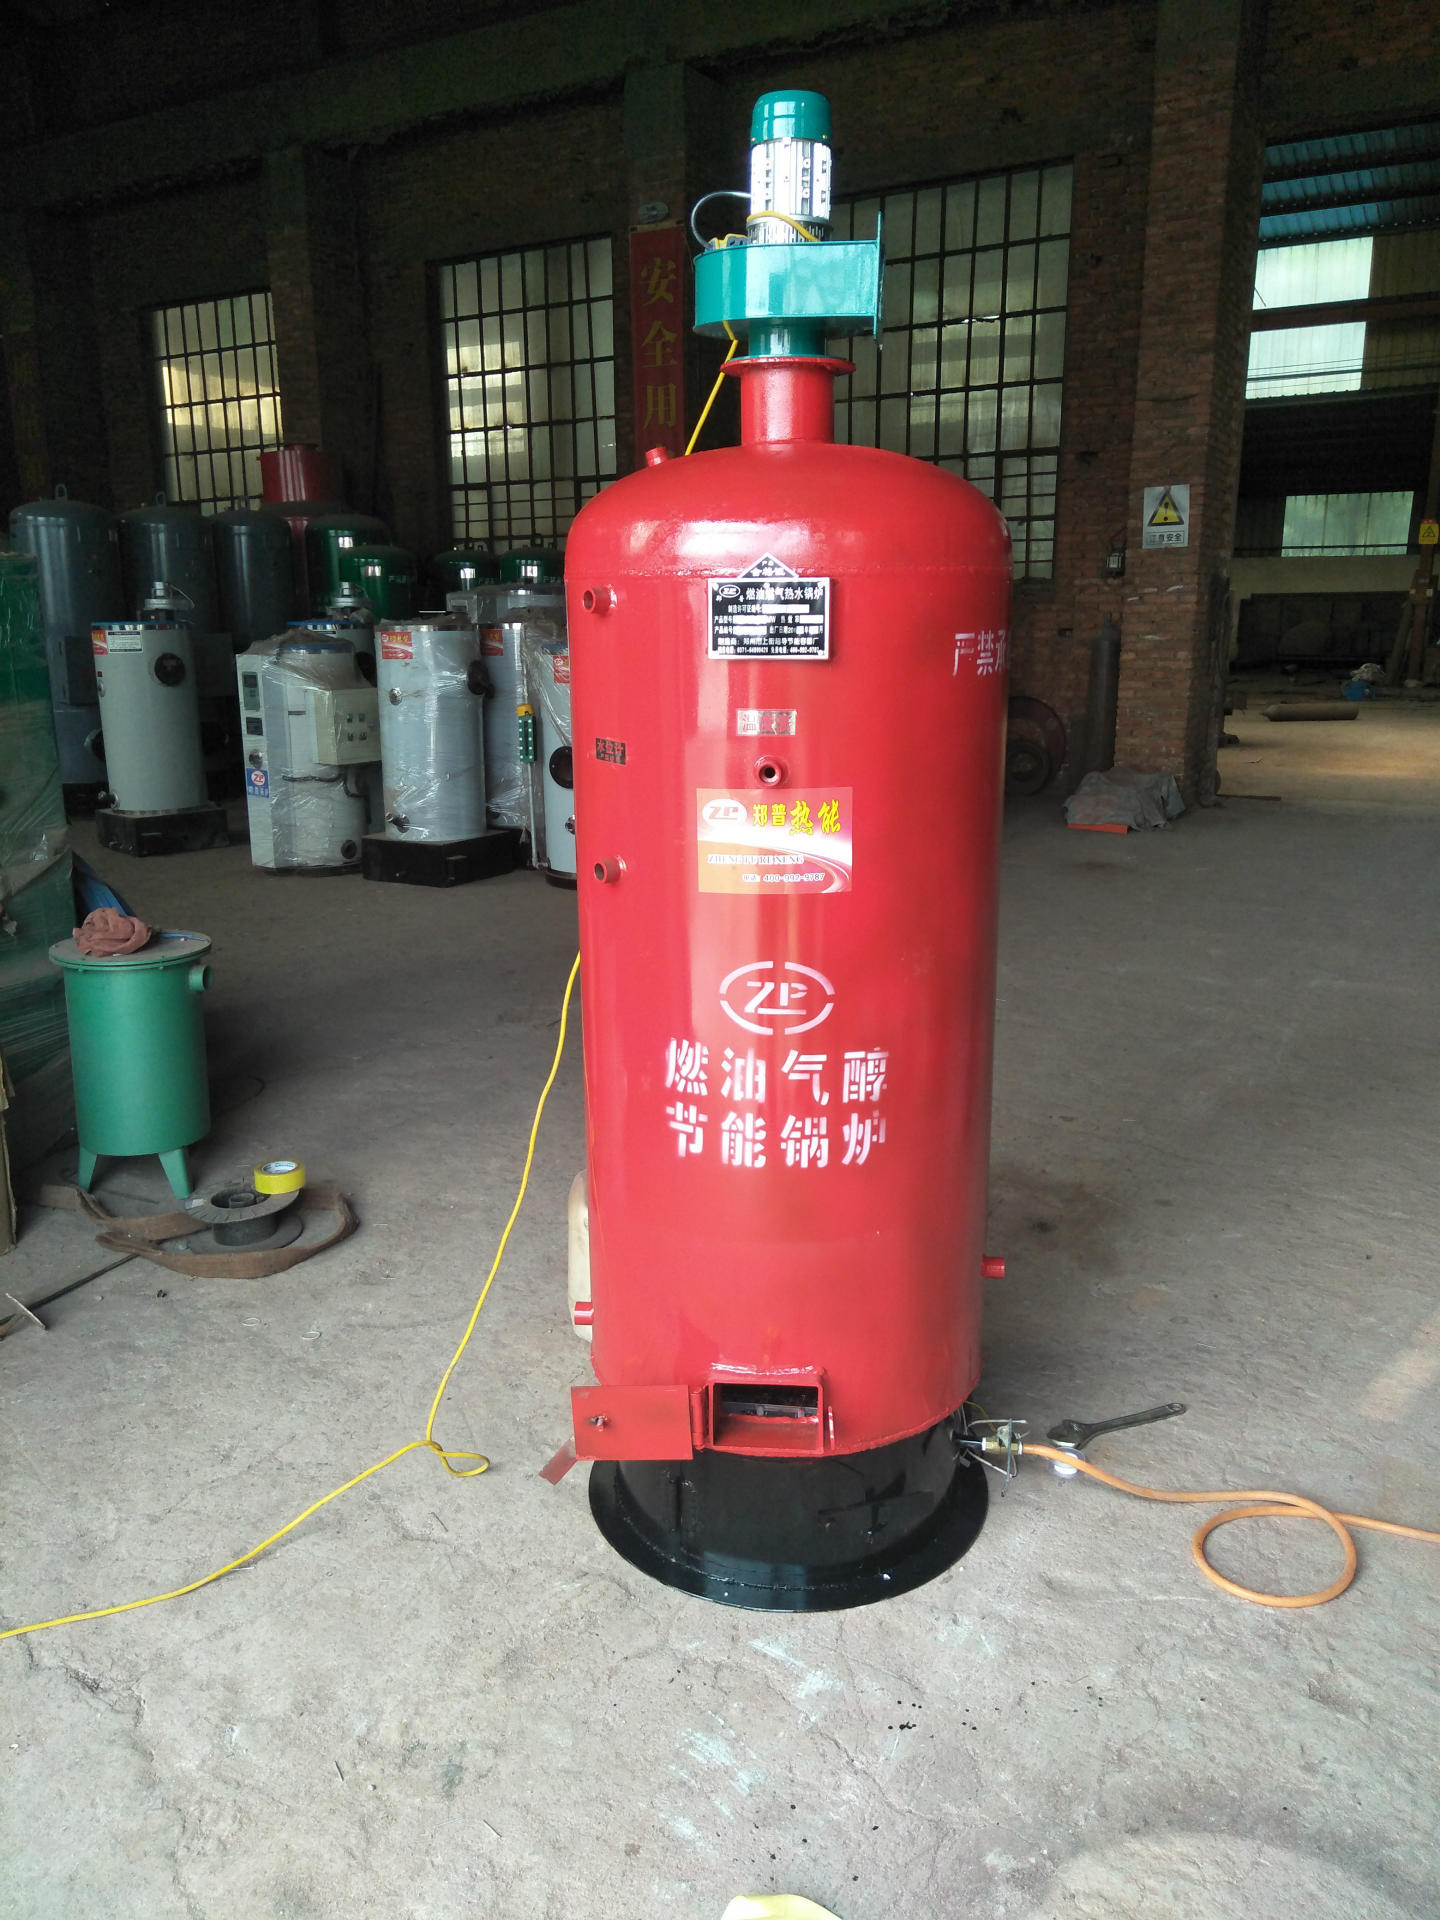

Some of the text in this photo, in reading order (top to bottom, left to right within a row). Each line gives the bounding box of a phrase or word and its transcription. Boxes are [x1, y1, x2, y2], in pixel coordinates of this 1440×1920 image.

[708, 806, 739, 820] ZP
[752, 799, 841, 836] 郑普热能
[744, 981, 809, 1016] ZP
[665, 1037, 890, 1107] 燃油气醇
[666, 1101, 888, 1169] 节能锅炉
